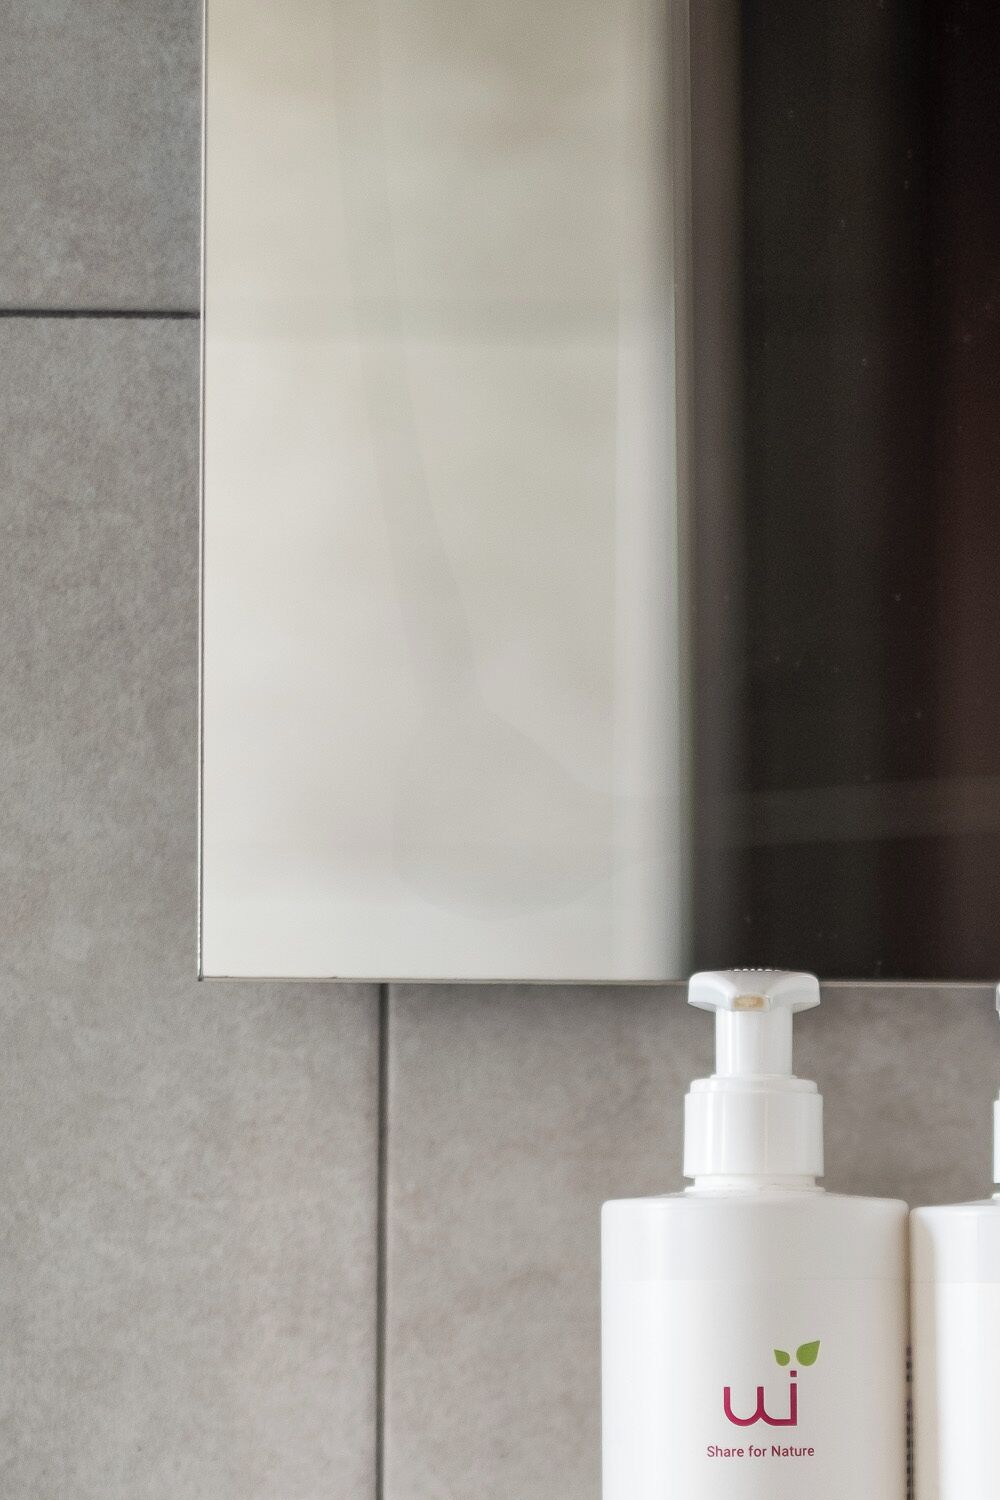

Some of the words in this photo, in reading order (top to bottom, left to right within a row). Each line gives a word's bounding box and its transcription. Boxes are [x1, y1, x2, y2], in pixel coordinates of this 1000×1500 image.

[706, 1444, 745, 1458] Share
[748, 1444, 768, 1458] for
[771, 1444, 815, 1458] Nature
